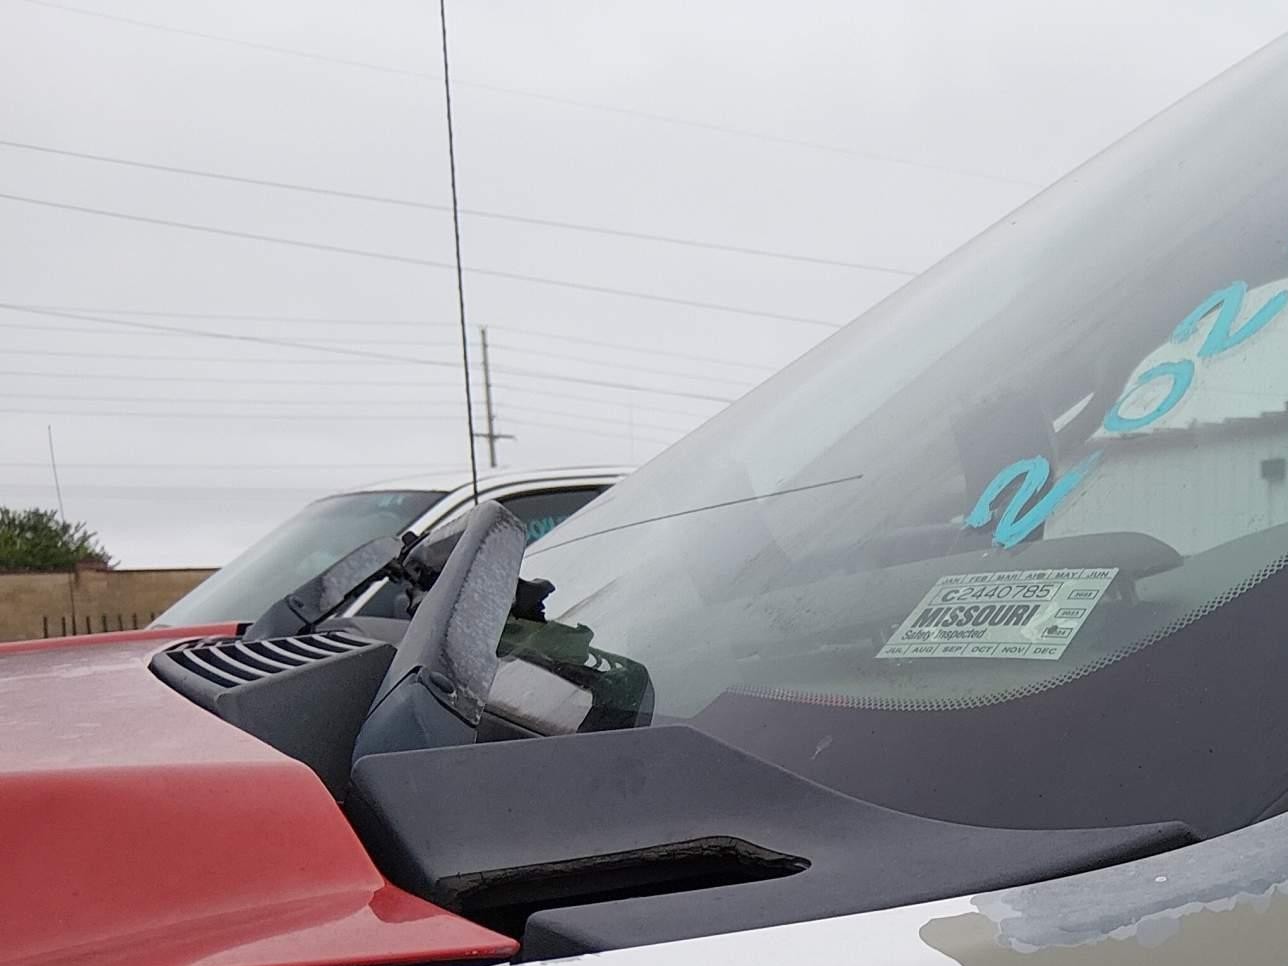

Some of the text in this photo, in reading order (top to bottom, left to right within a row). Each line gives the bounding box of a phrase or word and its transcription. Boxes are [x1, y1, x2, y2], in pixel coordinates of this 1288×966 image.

[1055, 570, 1079, 579] MAY
[1086, 570, 1109, 578] JUN
[941, 584, 1053, 602] C2440785
[910, 604, 1041, 629] MISSOURI
[901, 628, 987, 641] Safety Inspected
[912, 646, 935, 654] AUG
[971, 646, 994, 654] OCT
[1001, 646, 1027, 654] NOV
[1033, 647, 1057, 655] DEC
